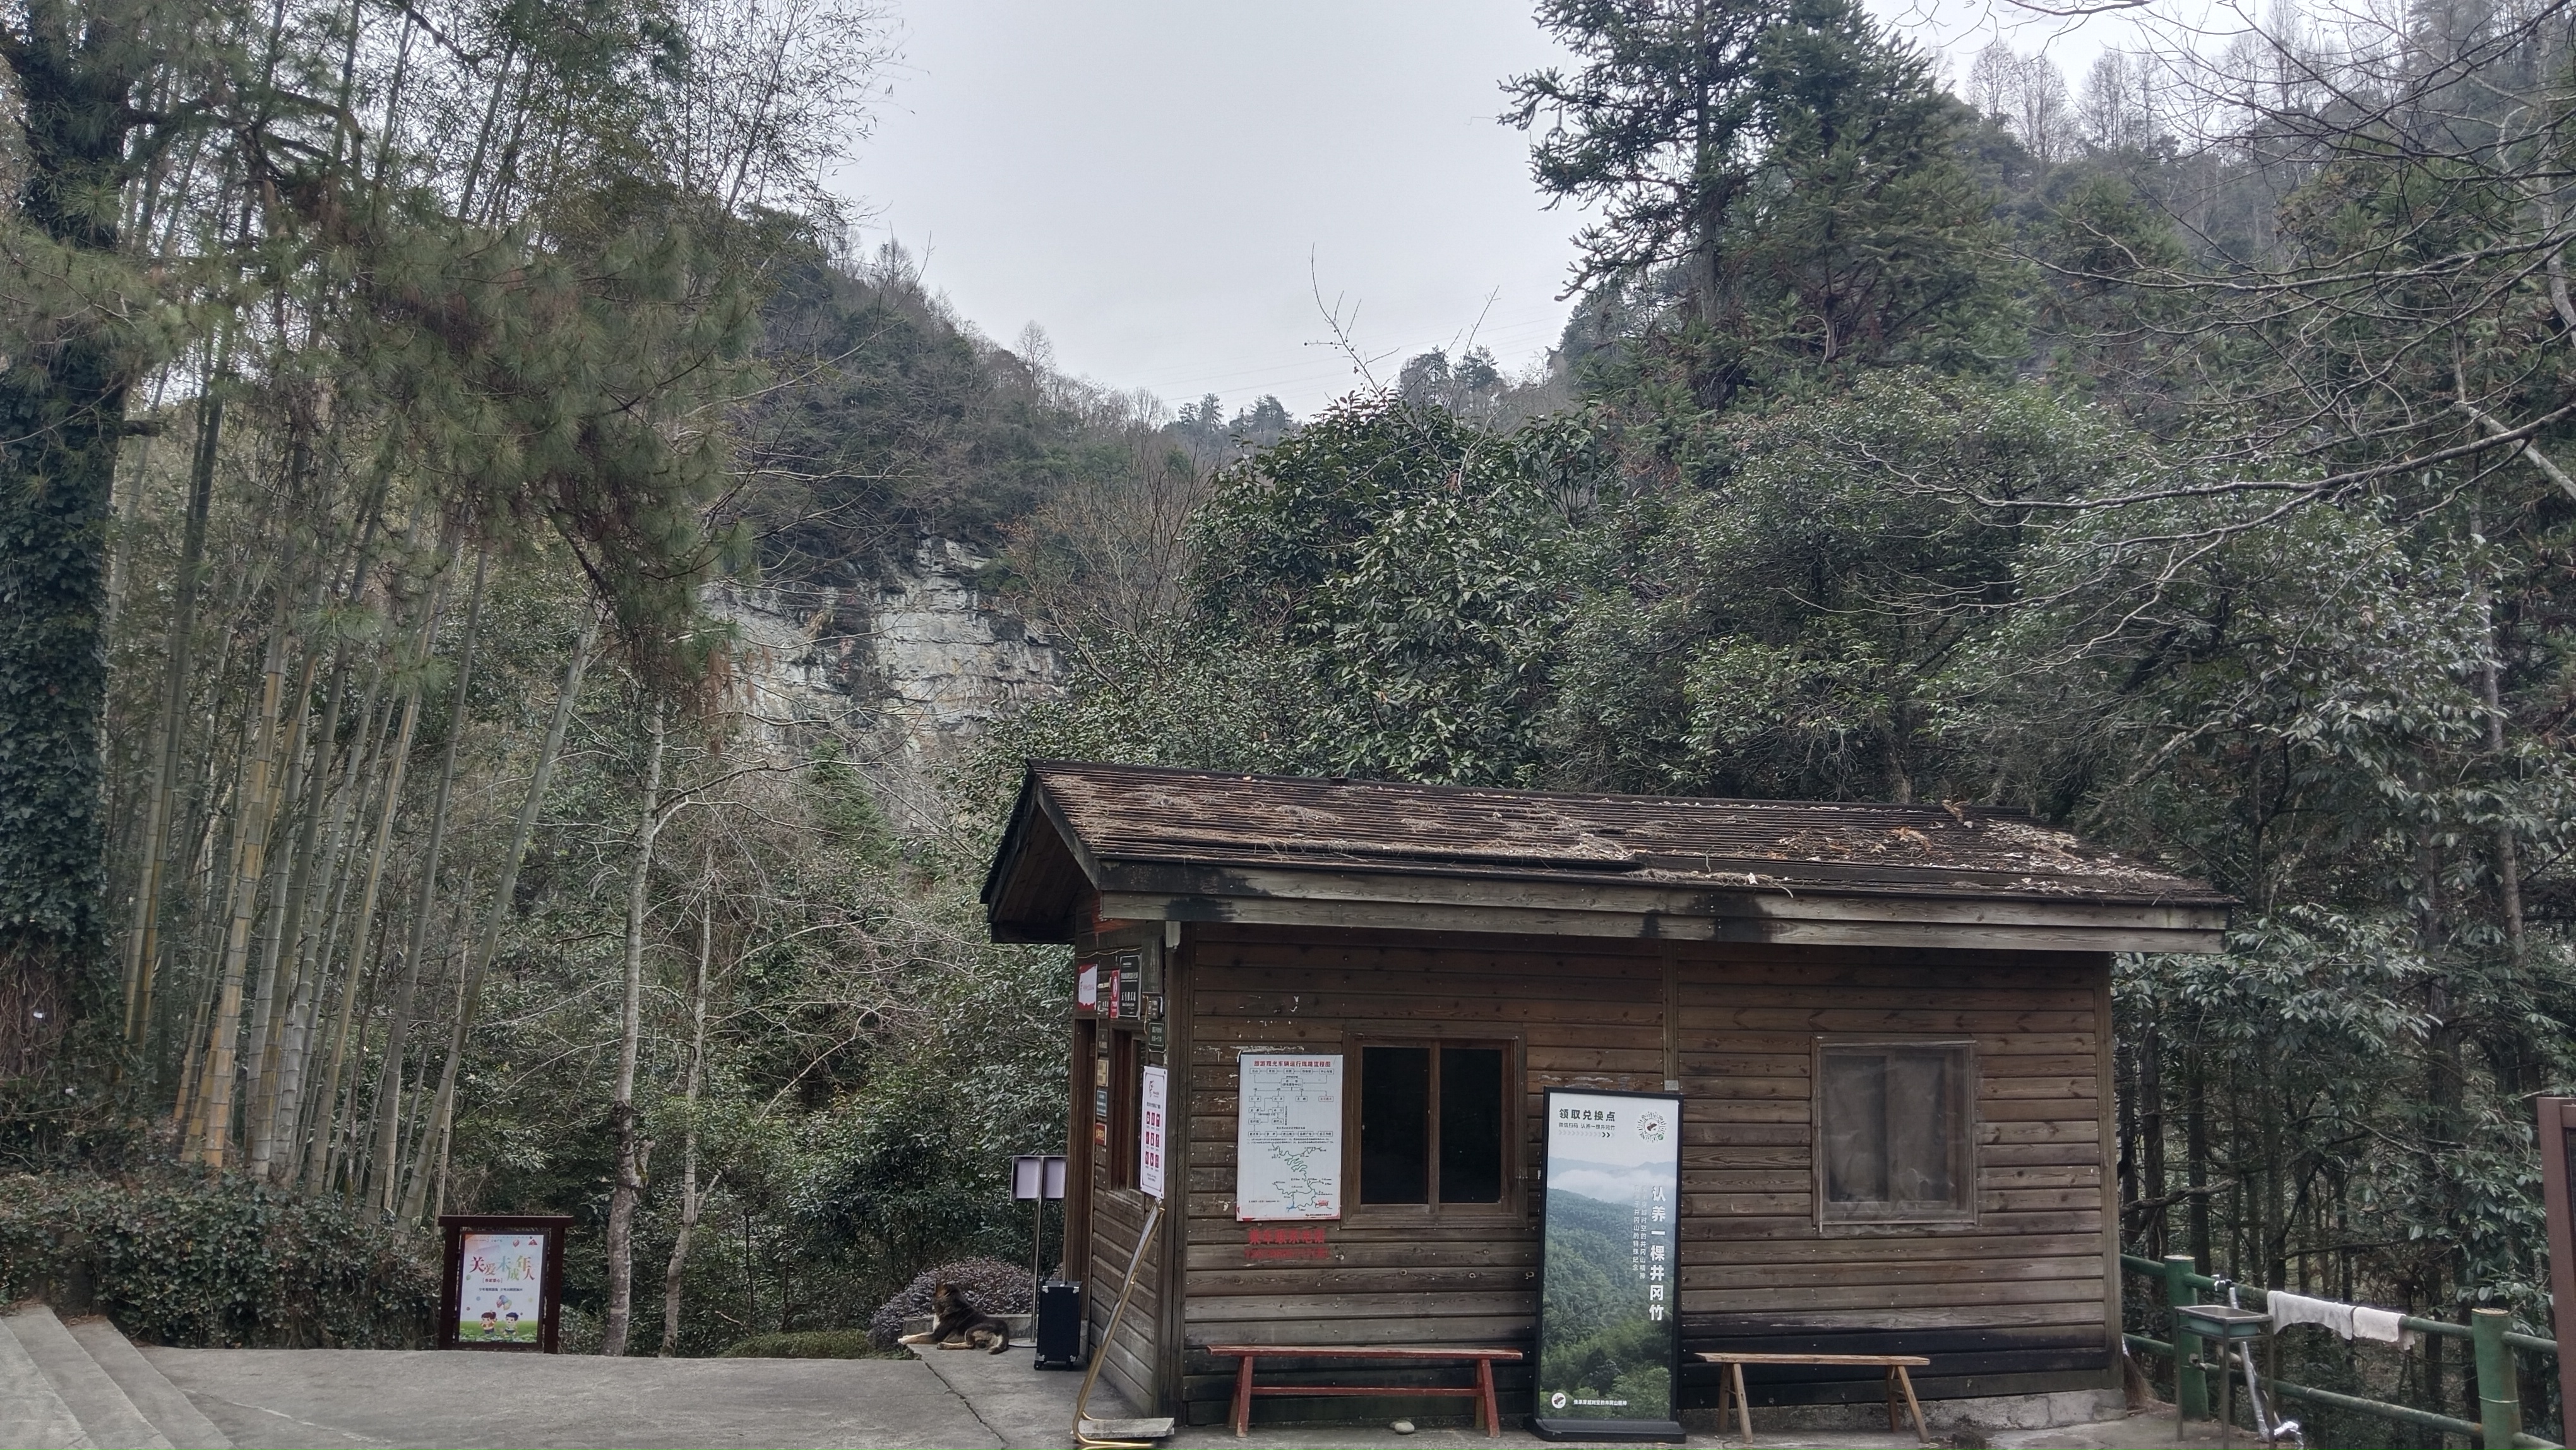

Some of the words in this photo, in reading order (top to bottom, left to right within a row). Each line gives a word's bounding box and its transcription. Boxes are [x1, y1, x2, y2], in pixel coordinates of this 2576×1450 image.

[1559, 1108, 1616, 1122] 领取兑换点
[1649, 1186, 1666, 1321] 认养一棵井冈竹
[469, 1255, 535, 1281] 关爱未成年人
